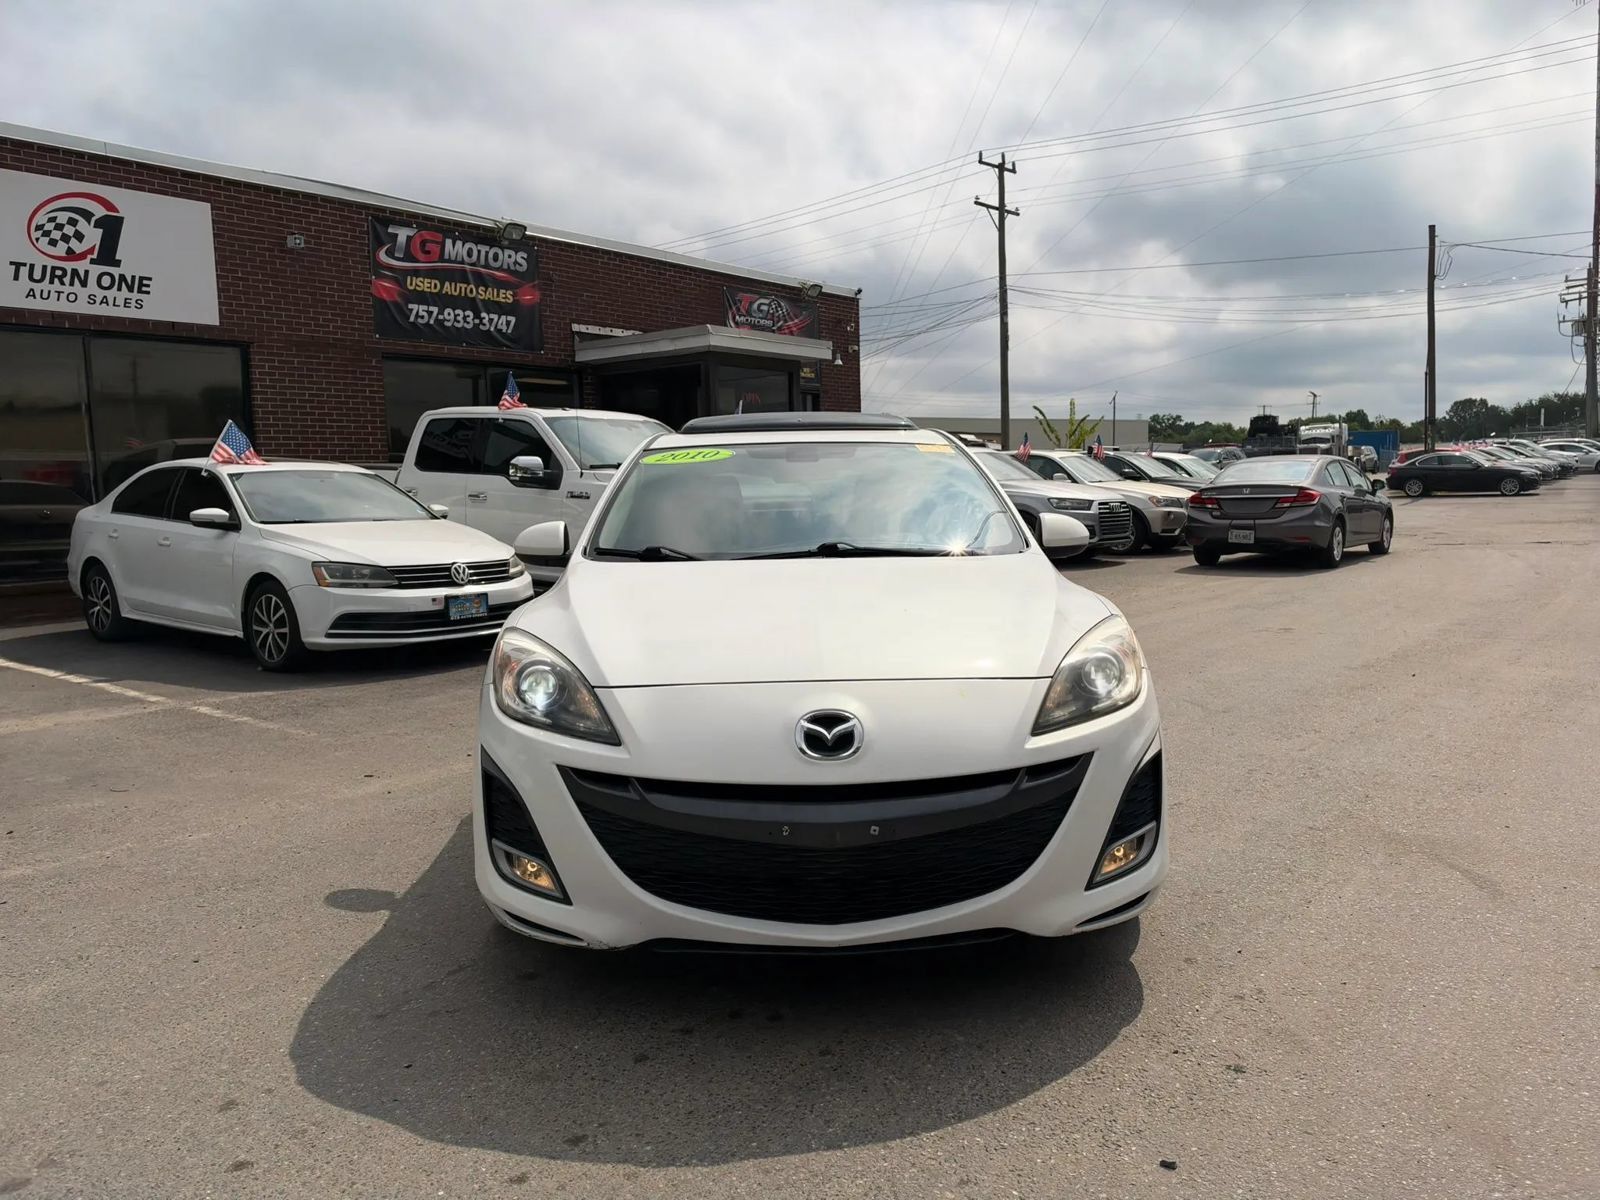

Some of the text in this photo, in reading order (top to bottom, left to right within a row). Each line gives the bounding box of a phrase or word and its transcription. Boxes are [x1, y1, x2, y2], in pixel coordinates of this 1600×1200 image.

[388, 225, 528, 272] TG MOTORS
[9, 261, 153, 295] TURN ONE
[406, 275, 514, 304] USED AUTO SALES
[25, 288, 145, 310] AUTO SALES
[408, 303, 517, 334] 757-933-3747
[735, 315, 774, 327] MOTORS
[655, 450, 721, 462] 2010
